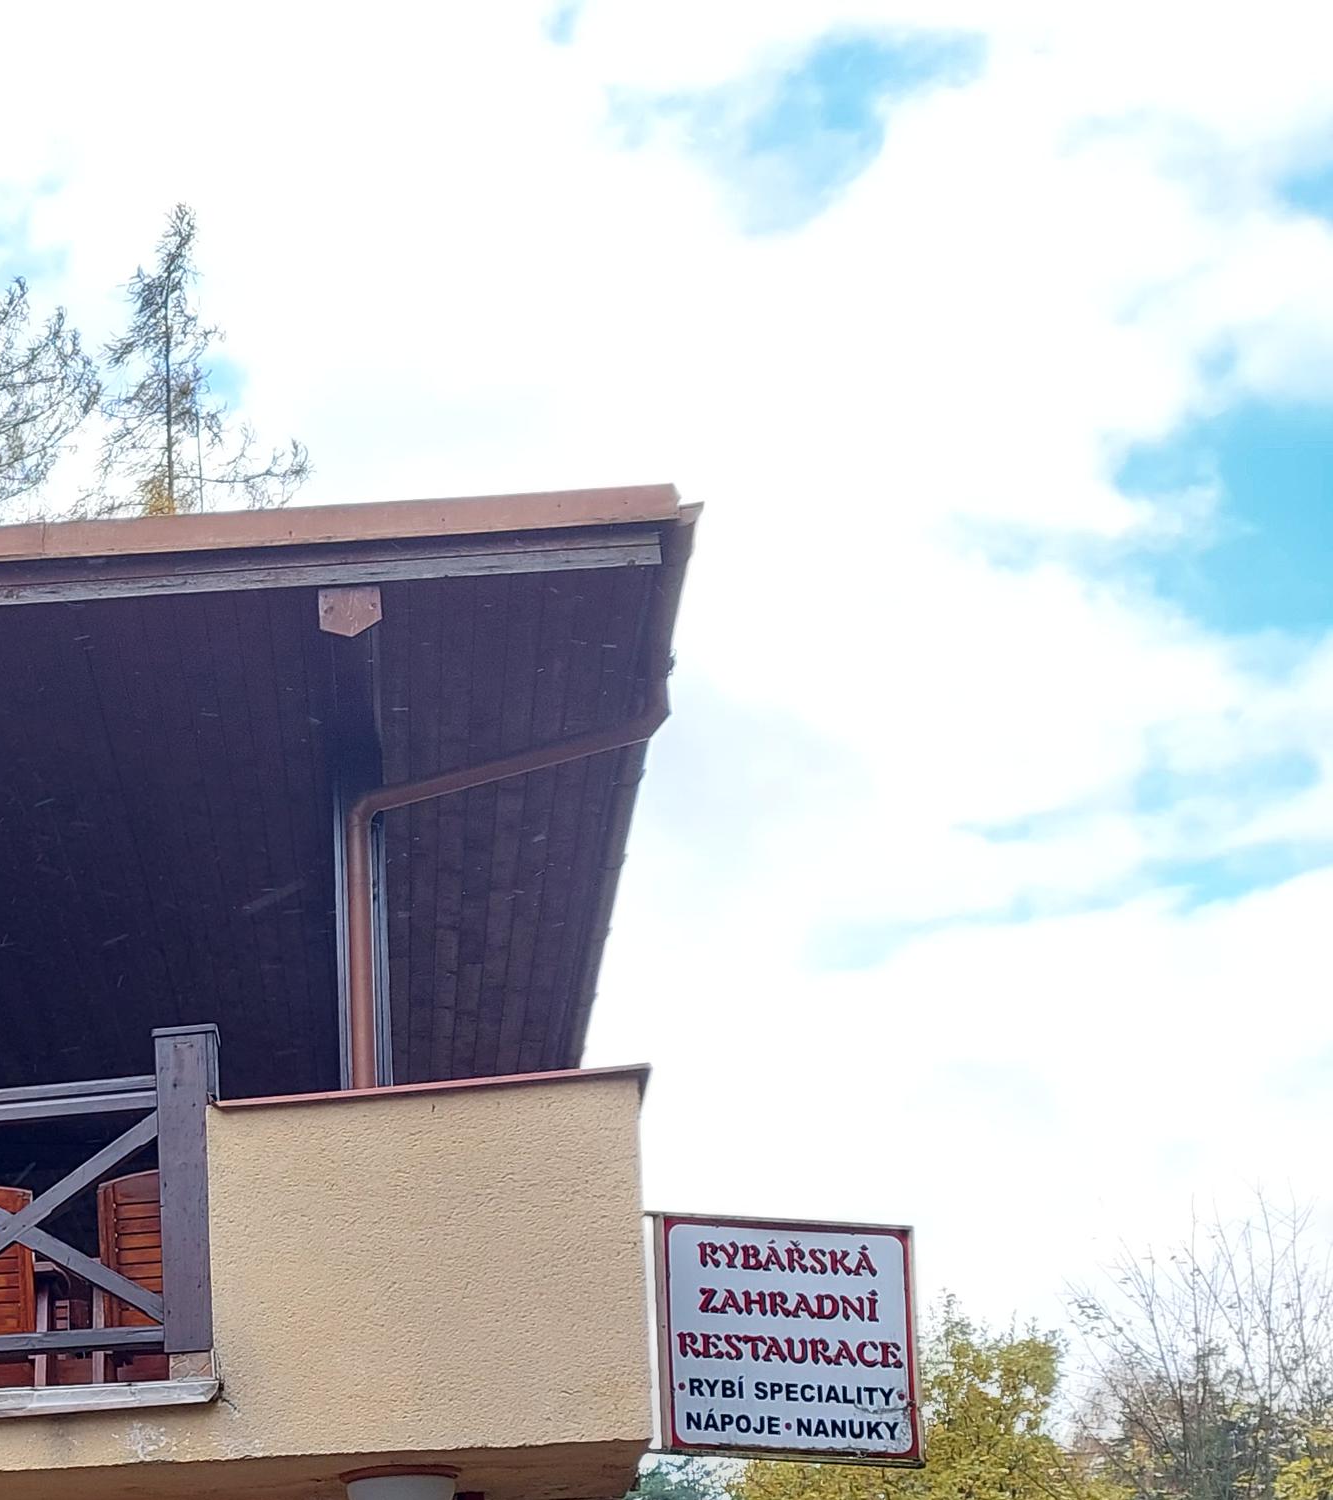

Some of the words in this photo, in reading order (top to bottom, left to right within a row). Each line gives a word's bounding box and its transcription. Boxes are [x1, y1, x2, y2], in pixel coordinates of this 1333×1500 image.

[697, 1240, 877, 1277] RYBÁŘSKÁ
[698, 1288, 879, 1322] ZAHRADNÍ
[677, 1332, 903, 1369] RESTAURACE
[689, 1376, 744, 1399] RYBÍ
[754, 1381, 894, 1406] SPECIALITY
[686, 1408, 781, 1435] NÁPOJE
[796, 1418, 899, 1440] NANUKY
